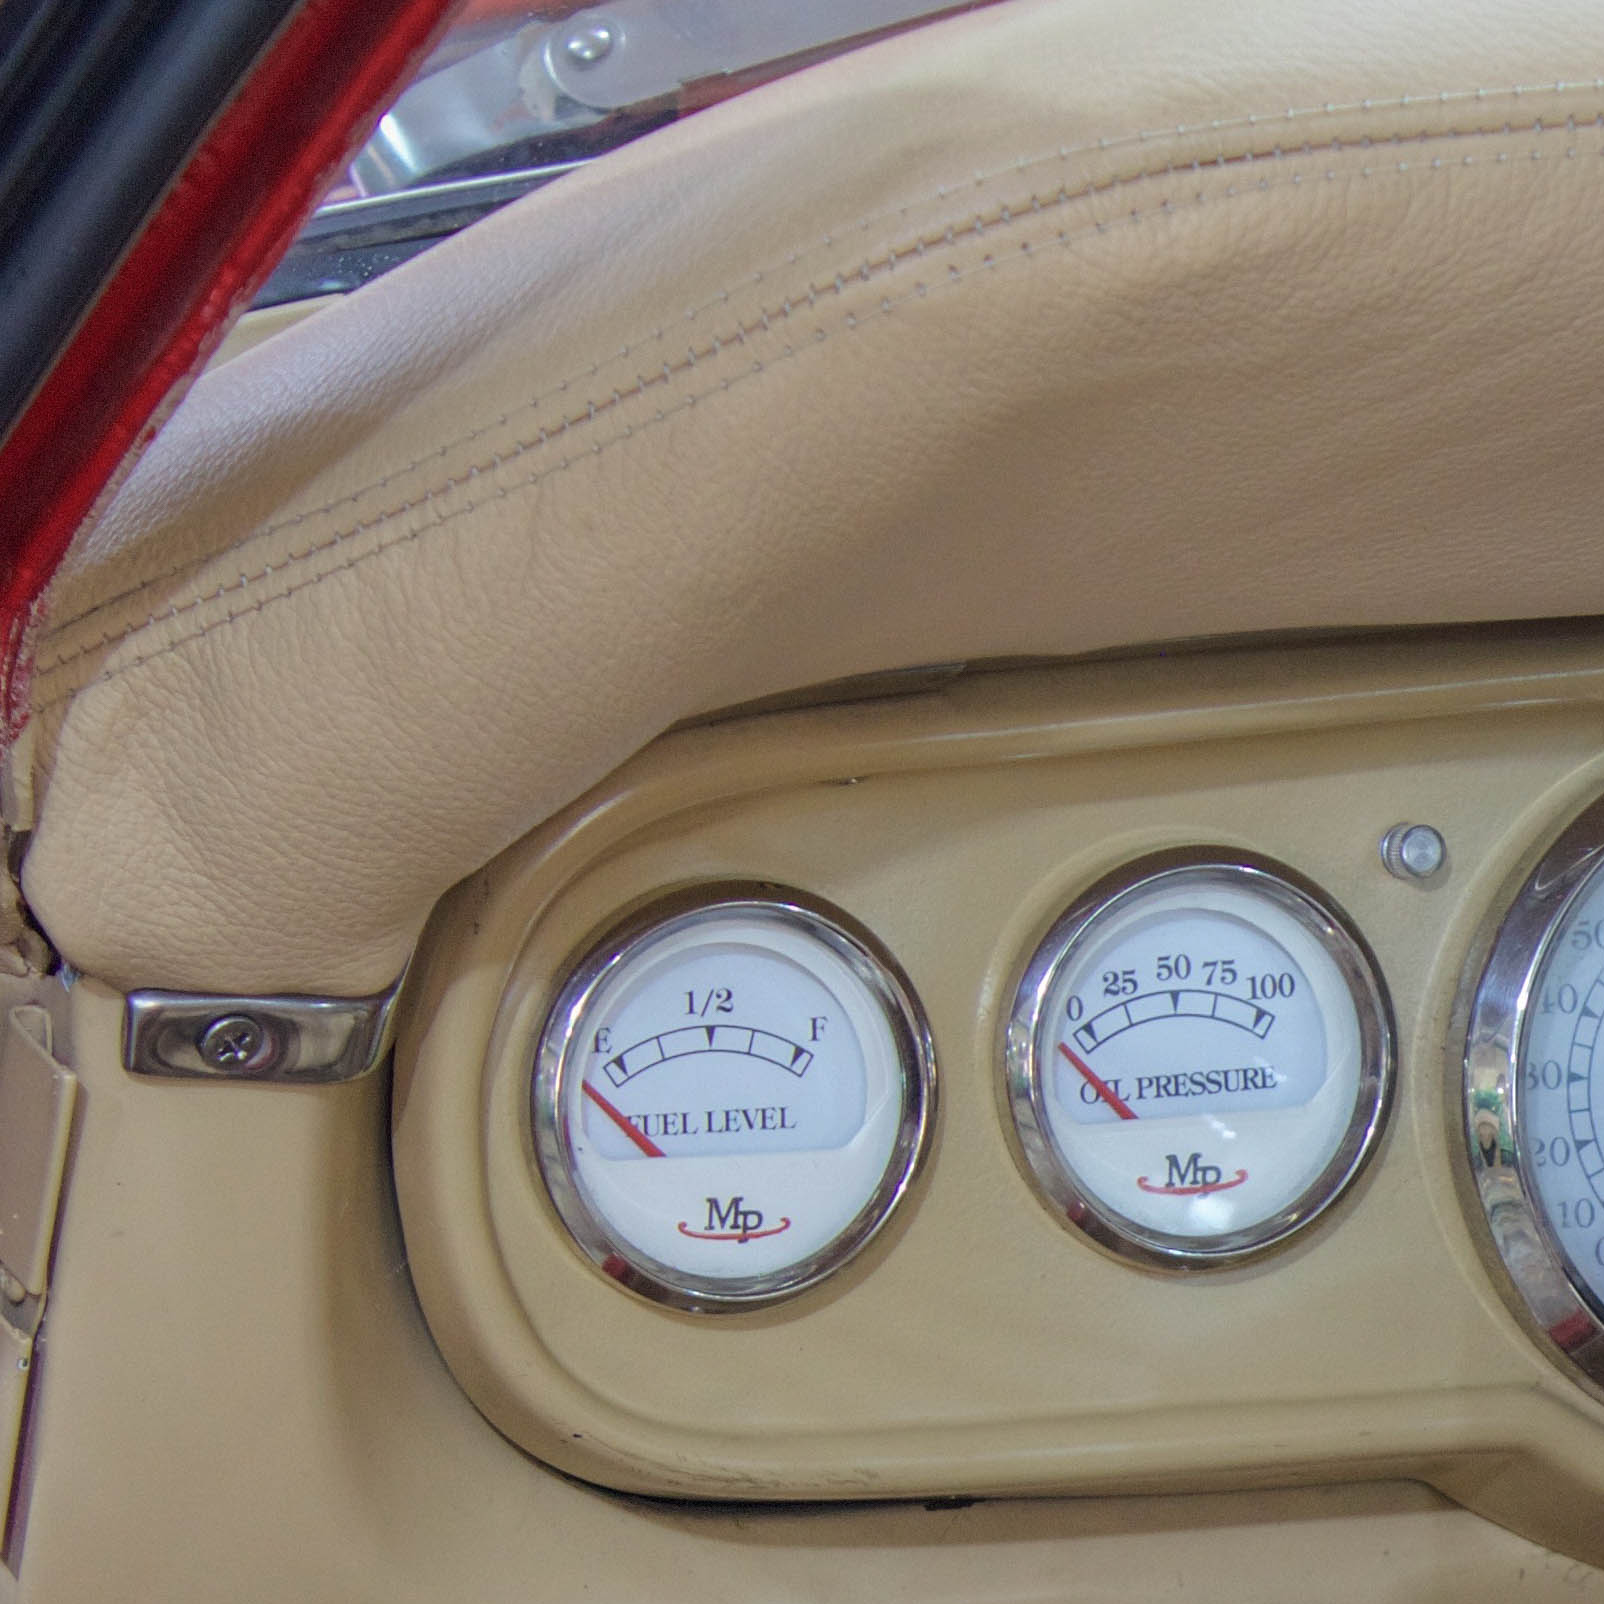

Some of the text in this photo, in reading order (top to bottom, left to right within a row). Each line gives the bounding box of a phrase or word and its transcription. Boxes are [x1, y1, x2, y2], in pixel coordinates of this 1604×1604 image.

[1156, 954, 1192, 981] 50
[1202, 959, 1238, 986] 75
[1102, 969, 1139, 997] 25
[1246, 973, 1296, 1000] 100
[684, 988, 734, 1018] 1/2
[1066, 995, 1084, 1022] 0
[591, 1027, 613, 1054] E
[808, 1016, 829, 1042] F
[1136, 1066, 1278, 1100] PRESSURE
[1526, 1059, 1562, 1091] 30
[705, 1106, 797, 1133] LEVEL
[1531, 1135, 1570, 1168] 20
[1557, 1197, 1595, 1229] 10
